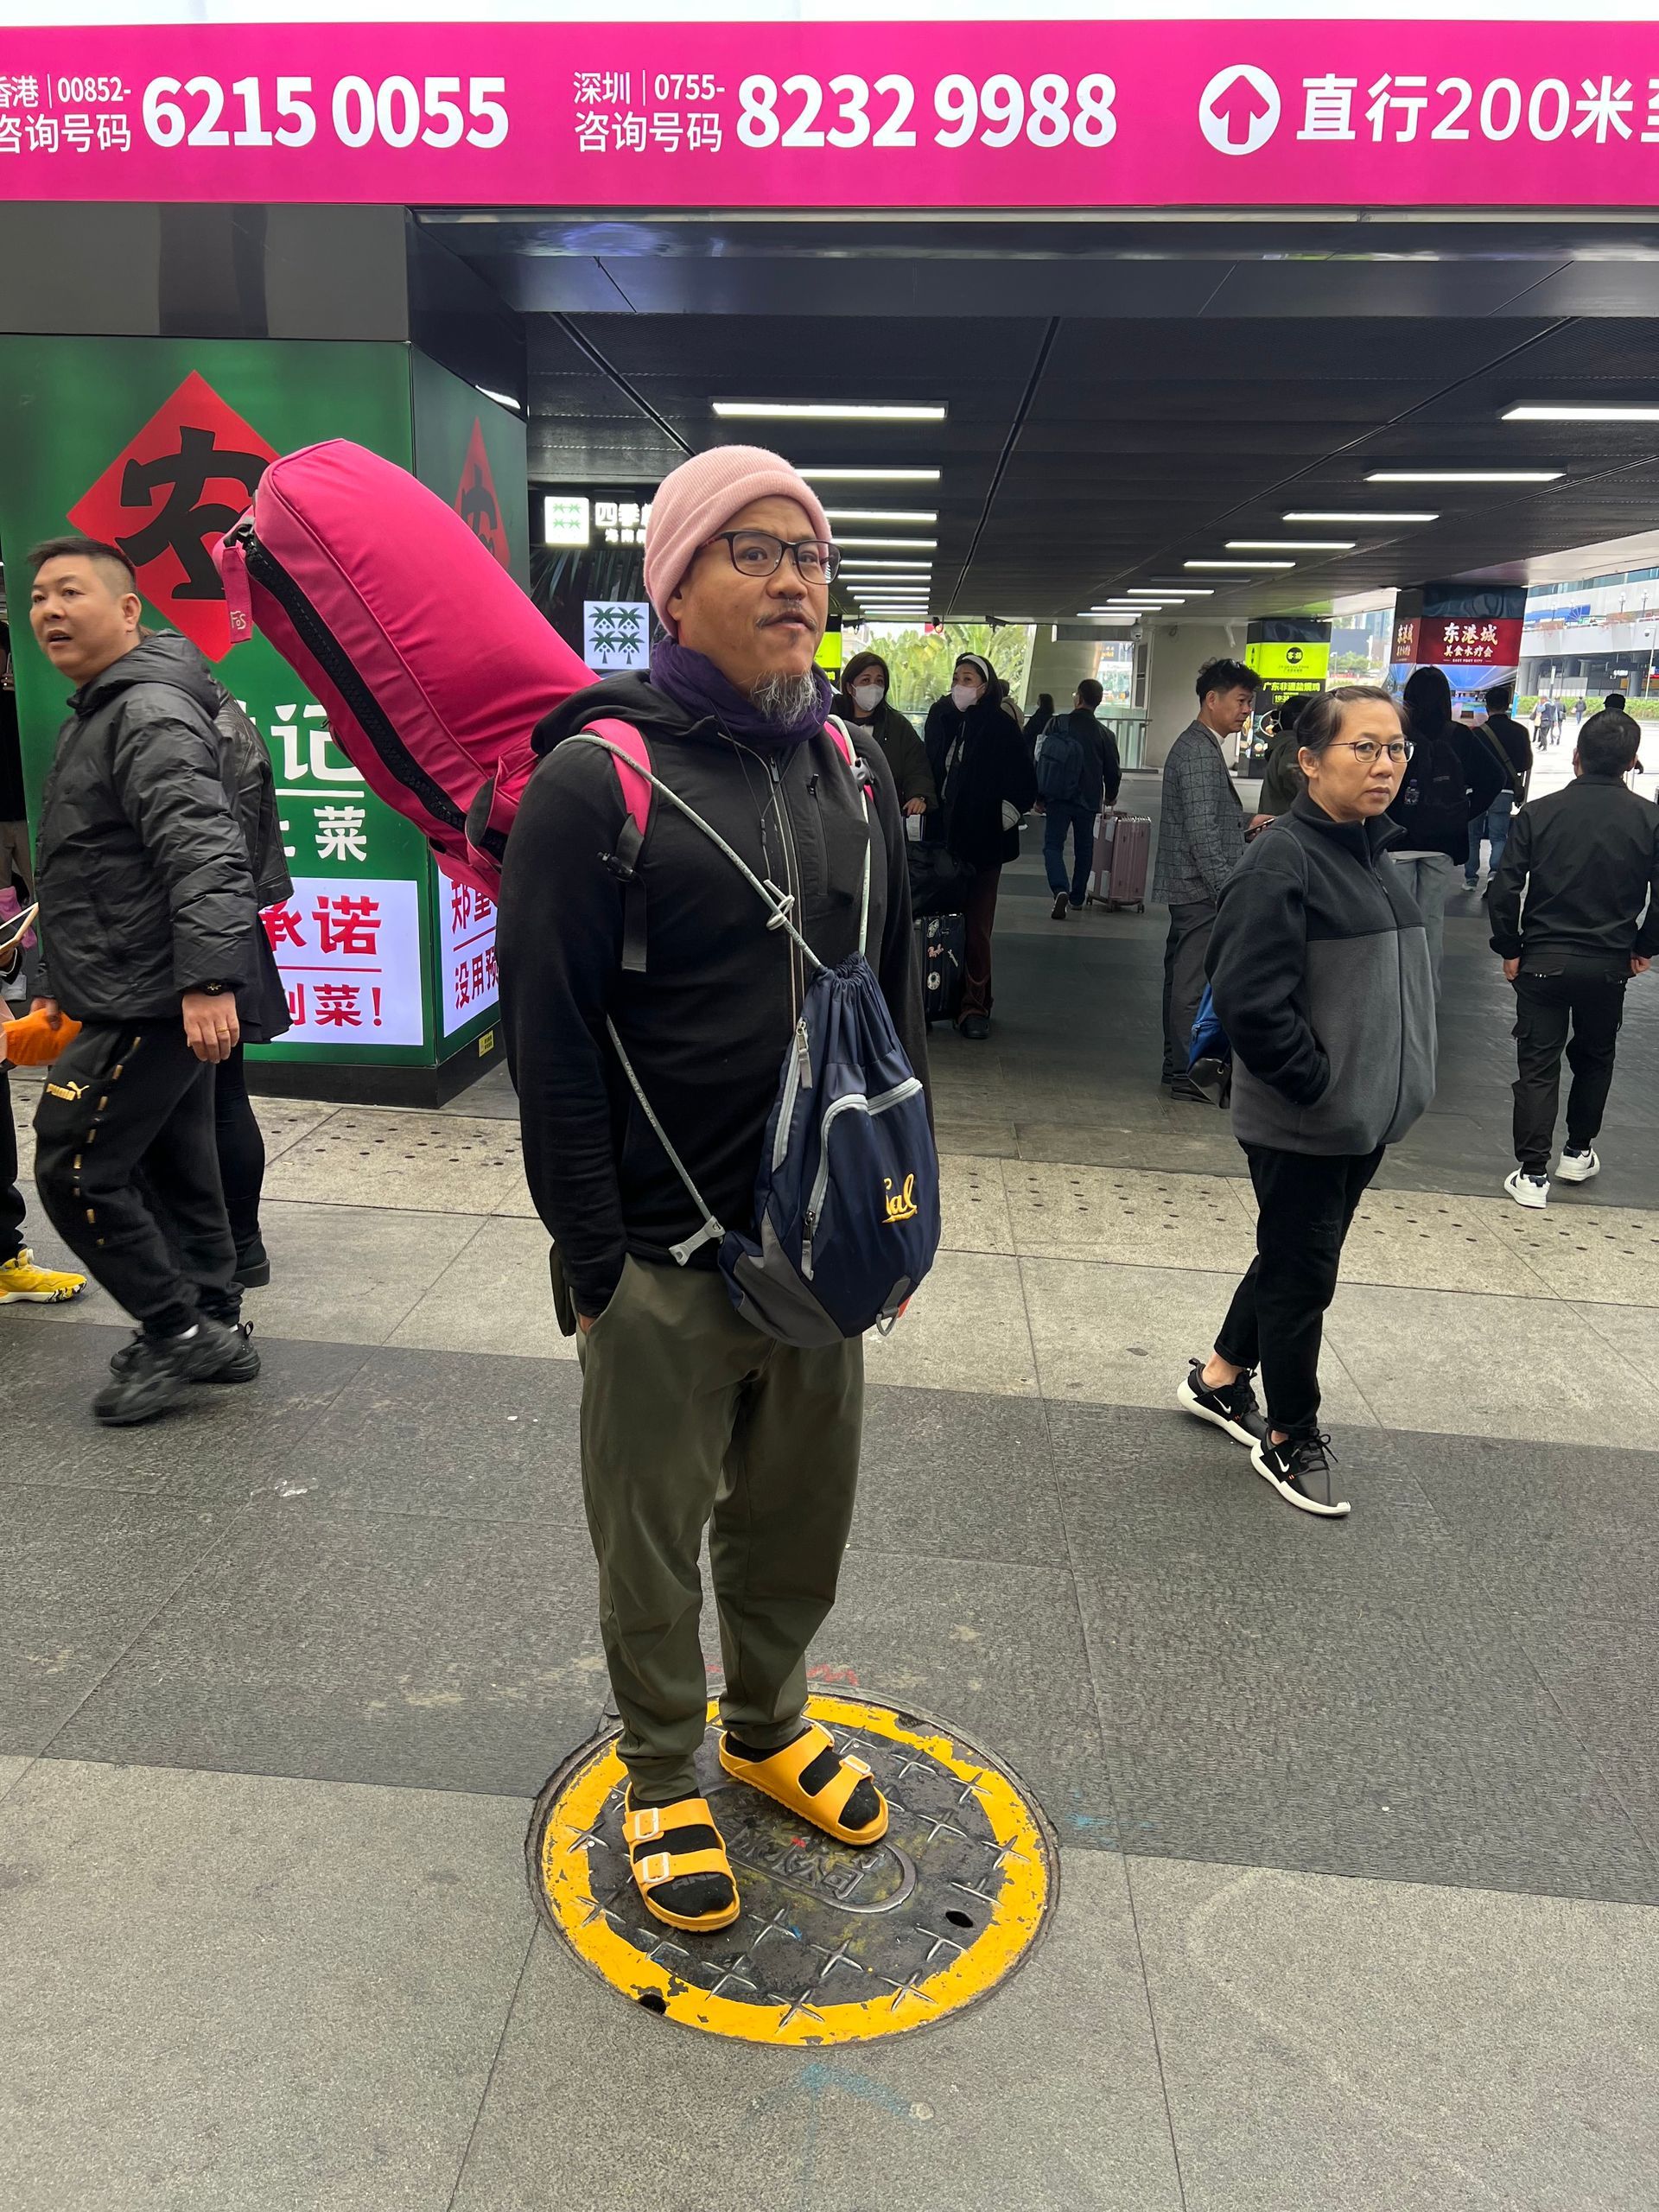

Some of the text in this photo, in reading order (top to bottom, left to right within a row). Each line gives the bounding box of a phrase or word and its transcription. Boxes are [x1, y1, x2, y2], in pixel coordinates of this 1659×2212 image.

[57, 76, 131, 102] 00852-
[573, 71, 726, 105] 深圳 0755-
[143, 75, 509, 148] 6215 0055
[736, 73, 1117, 148] 8232 9988
[0, 113, 131, 153] 咨询号码
[575, 111, 722, 152] 咨询号码
[1443, 622, 1498, 645] 东港城
[1444, 645, 1494, 658] 美食水疗会
[258, 895, 382, 955] 承诺
